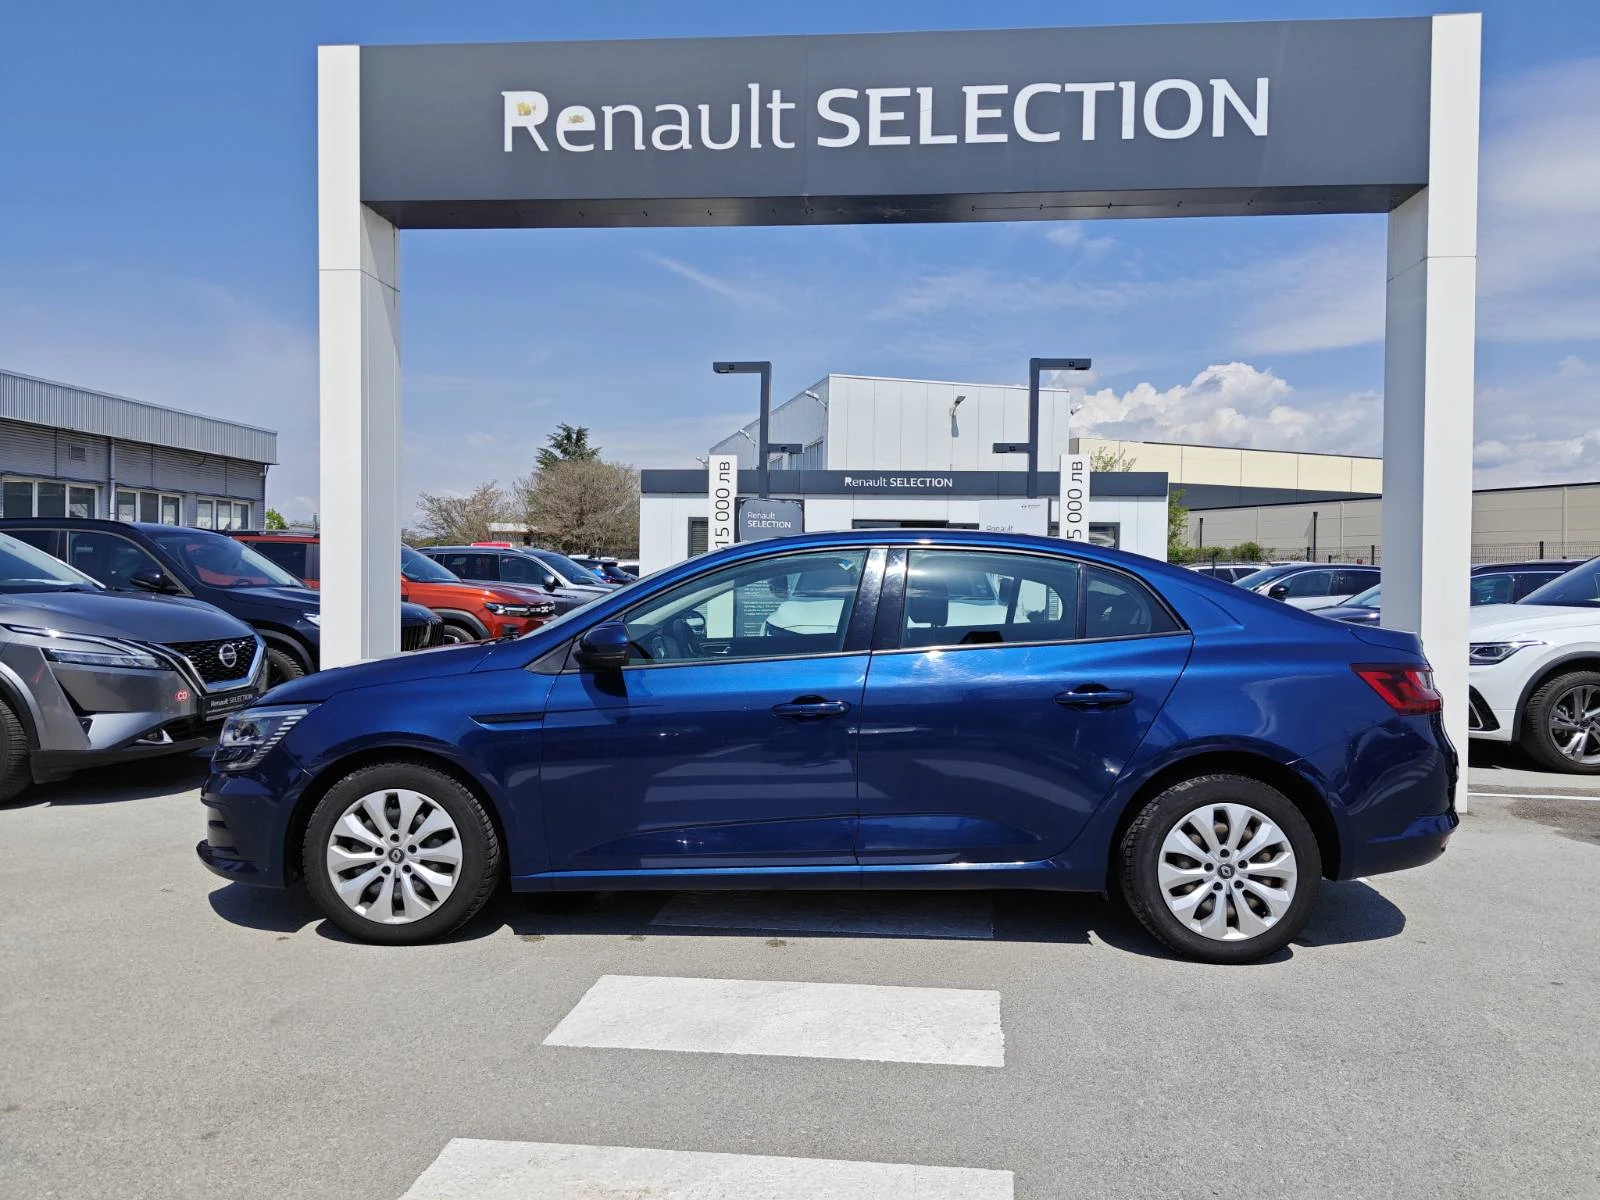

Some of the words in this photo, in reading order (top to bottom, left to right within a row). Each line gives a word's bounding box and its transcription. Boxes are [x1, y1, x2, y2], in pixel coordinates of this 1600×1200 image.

[501, 83, 796, 152] Renault
[816, 77, 1270, 148] SELECTION
[844, 476, 888, 487] Renault
[889, 477, 953, 488] SELECTION
[715, 488, 730, 522] 000
[747, 511, 776, 520] Renault
[1066, 488, 1083, 523] 000
[747, 520, 792, 529] SELECTION
[715, 527, 730, 548] 15
